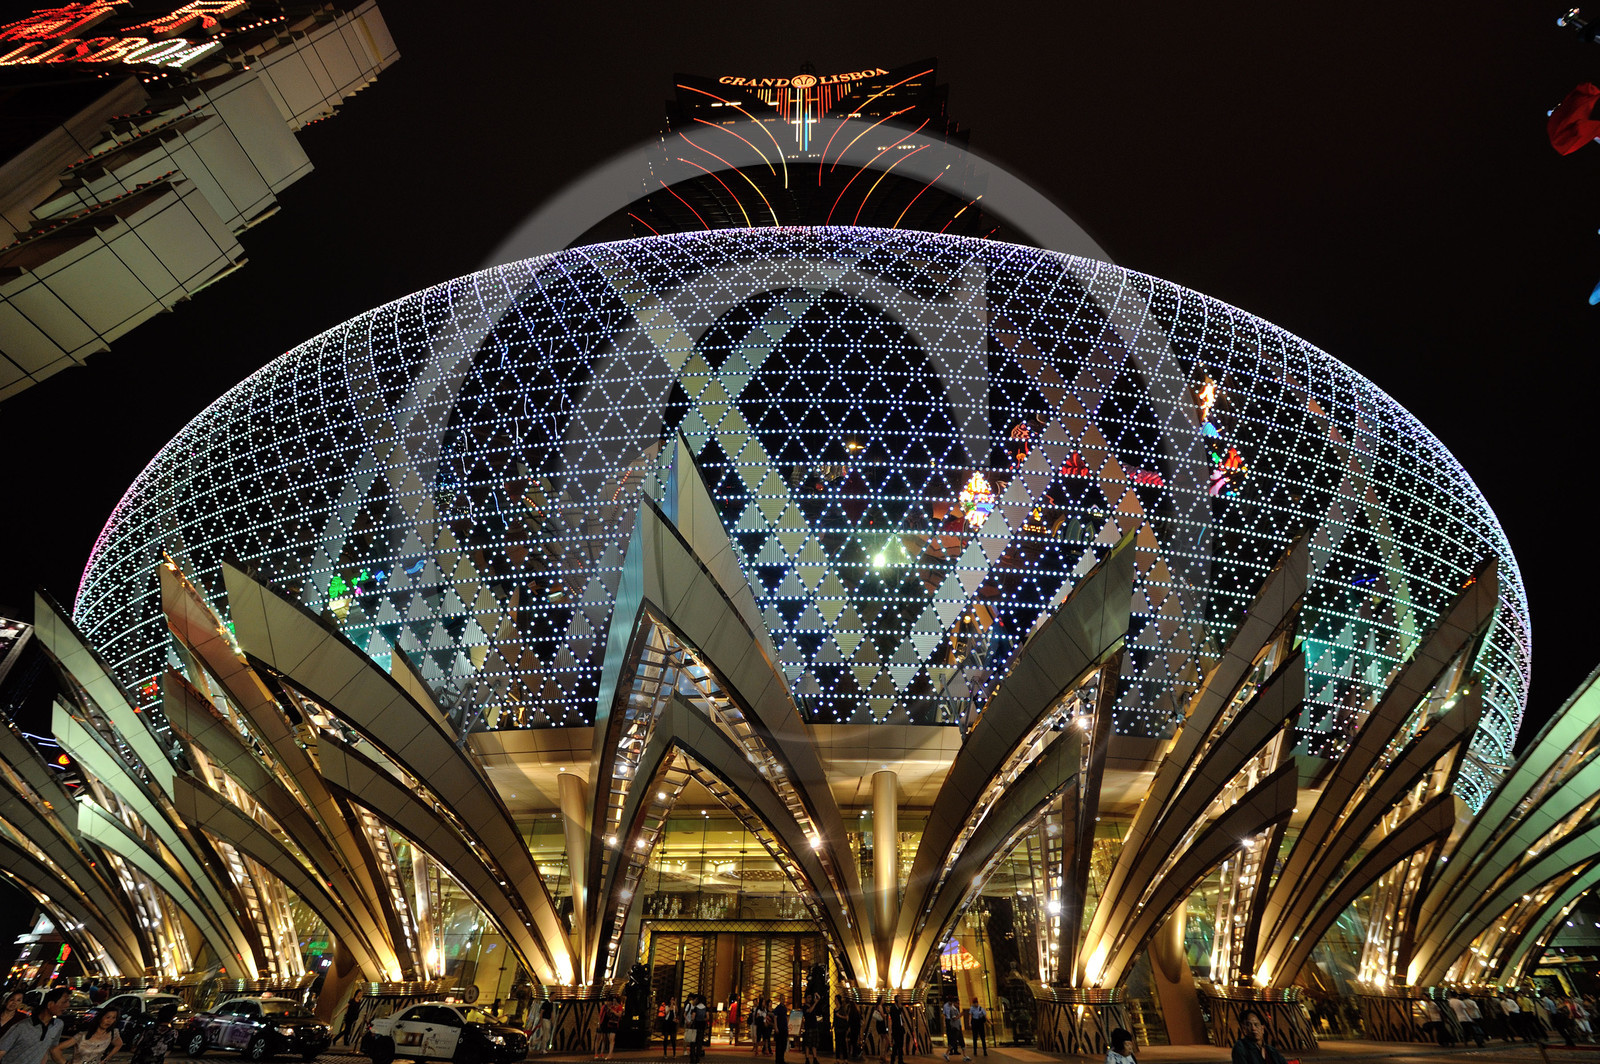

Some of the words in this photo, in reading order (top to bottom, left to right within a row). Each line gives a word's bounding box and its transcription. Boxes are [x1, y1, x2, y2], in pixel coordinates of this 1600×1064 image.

[0, 37, 221, 68] LISBOA
[718, 75, 790, 88] GRAND
[818, 67, 890, 85] LISBOA
